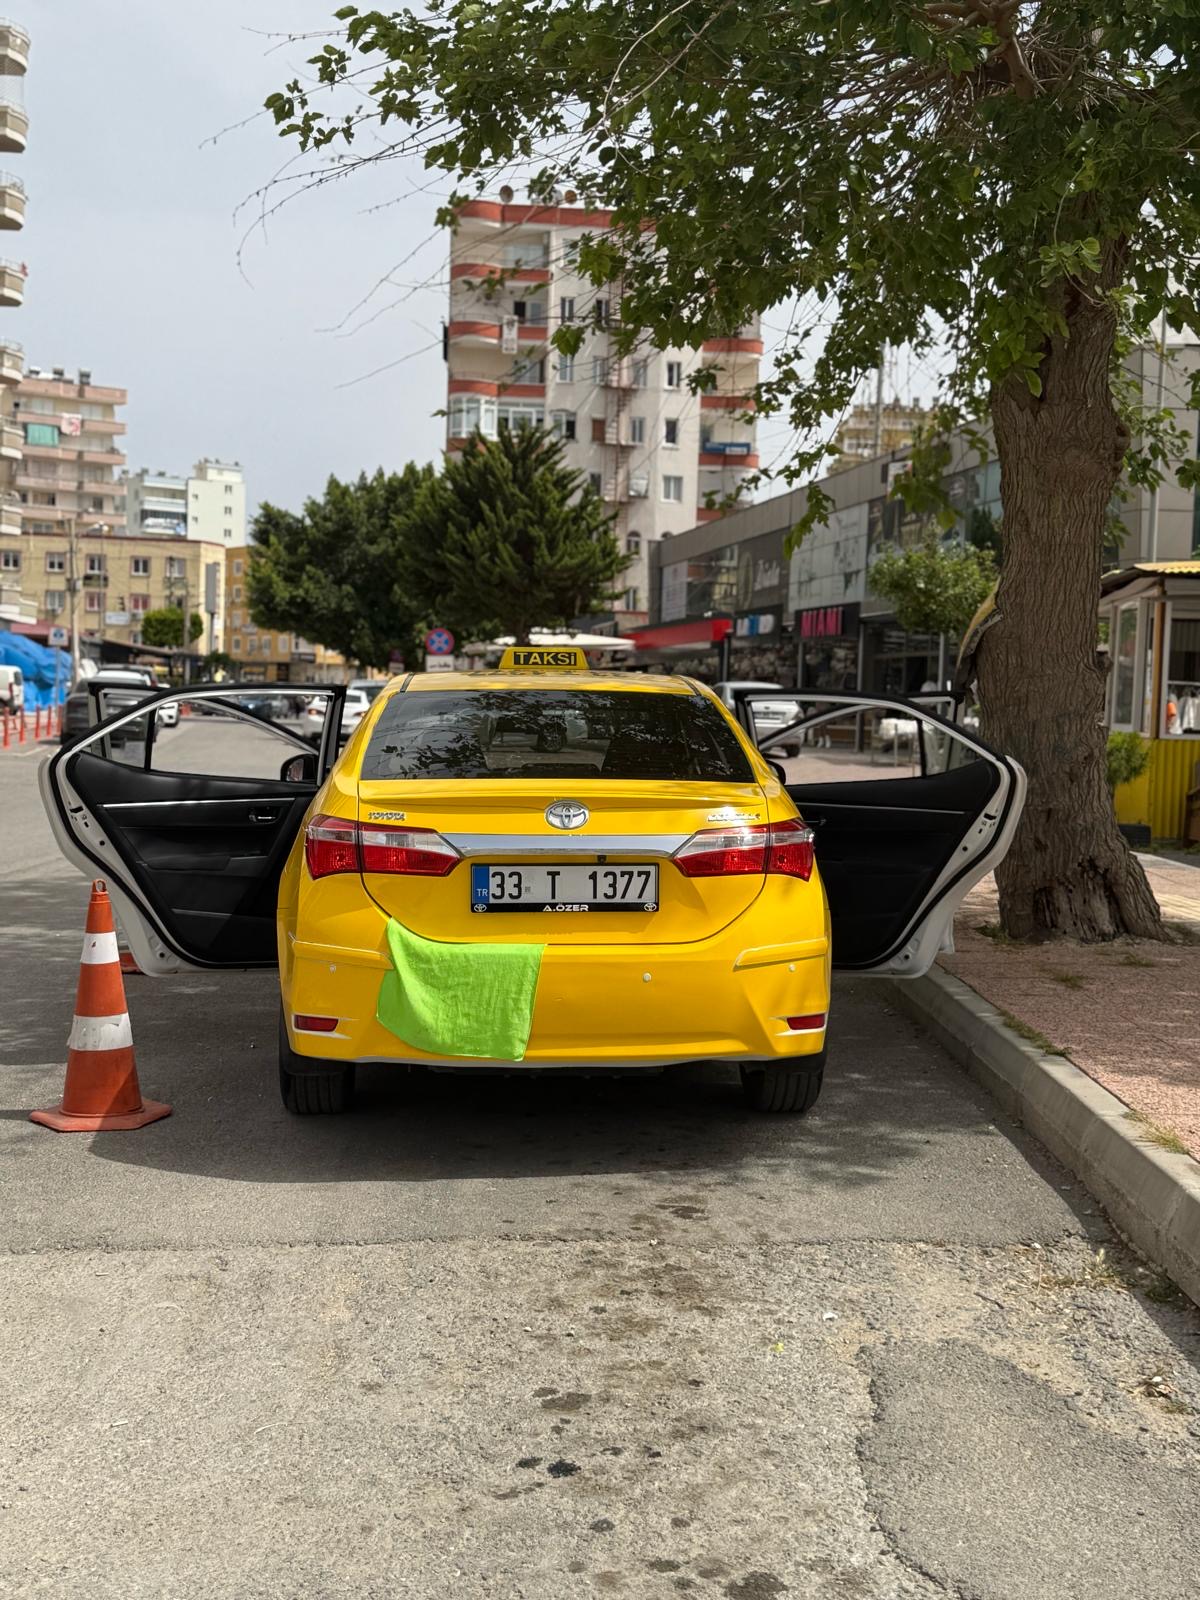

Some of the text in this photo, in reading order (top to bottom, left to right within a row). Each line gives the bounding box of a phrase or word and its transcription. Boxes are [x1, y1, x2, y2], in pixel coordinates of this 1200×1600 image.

[491, 871, 652, 900] 33 T 1377
[476, 888, 489, 897] TR
[542, 902, 589, 912] A.ÖZER
